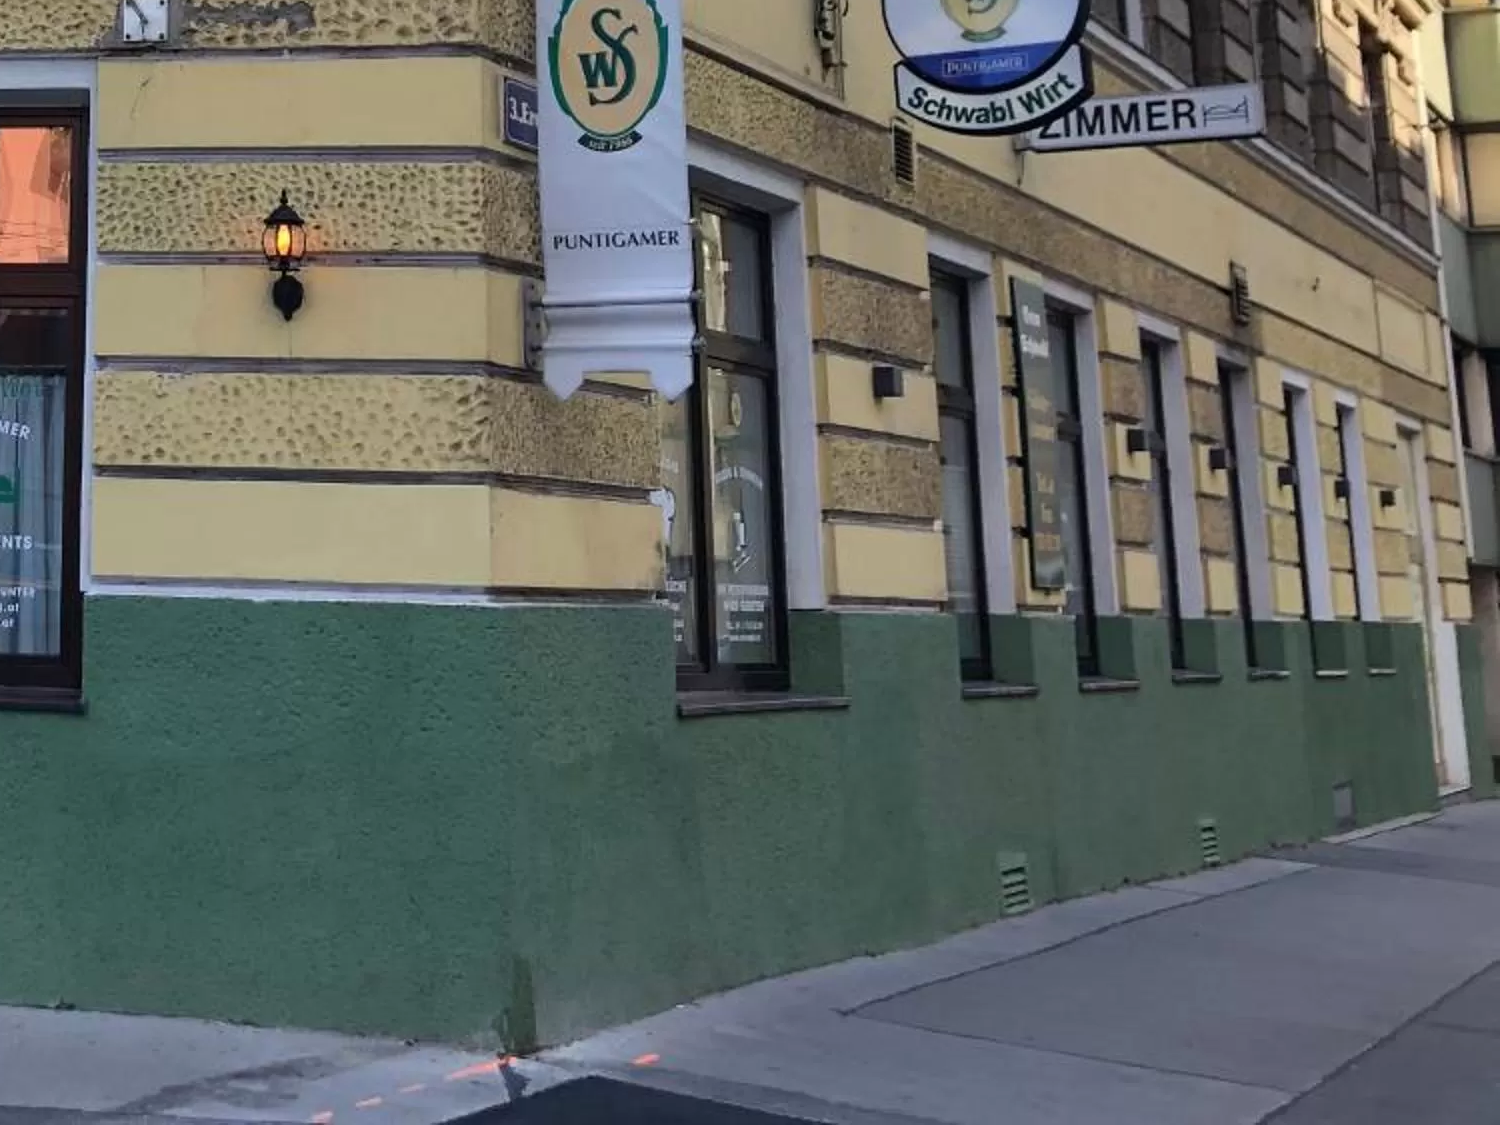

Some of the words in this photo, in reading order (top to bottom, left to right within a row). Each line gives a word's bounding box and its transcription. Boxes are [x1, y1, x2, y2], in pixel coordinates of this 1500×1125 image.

[907, 86, 1013, 125] Schwabl
[1017, 71, 1076, 115] Wirt
[553, 228, 680, 251] PUNTIGAMER
[1, 586, 37, 598] UNTER
